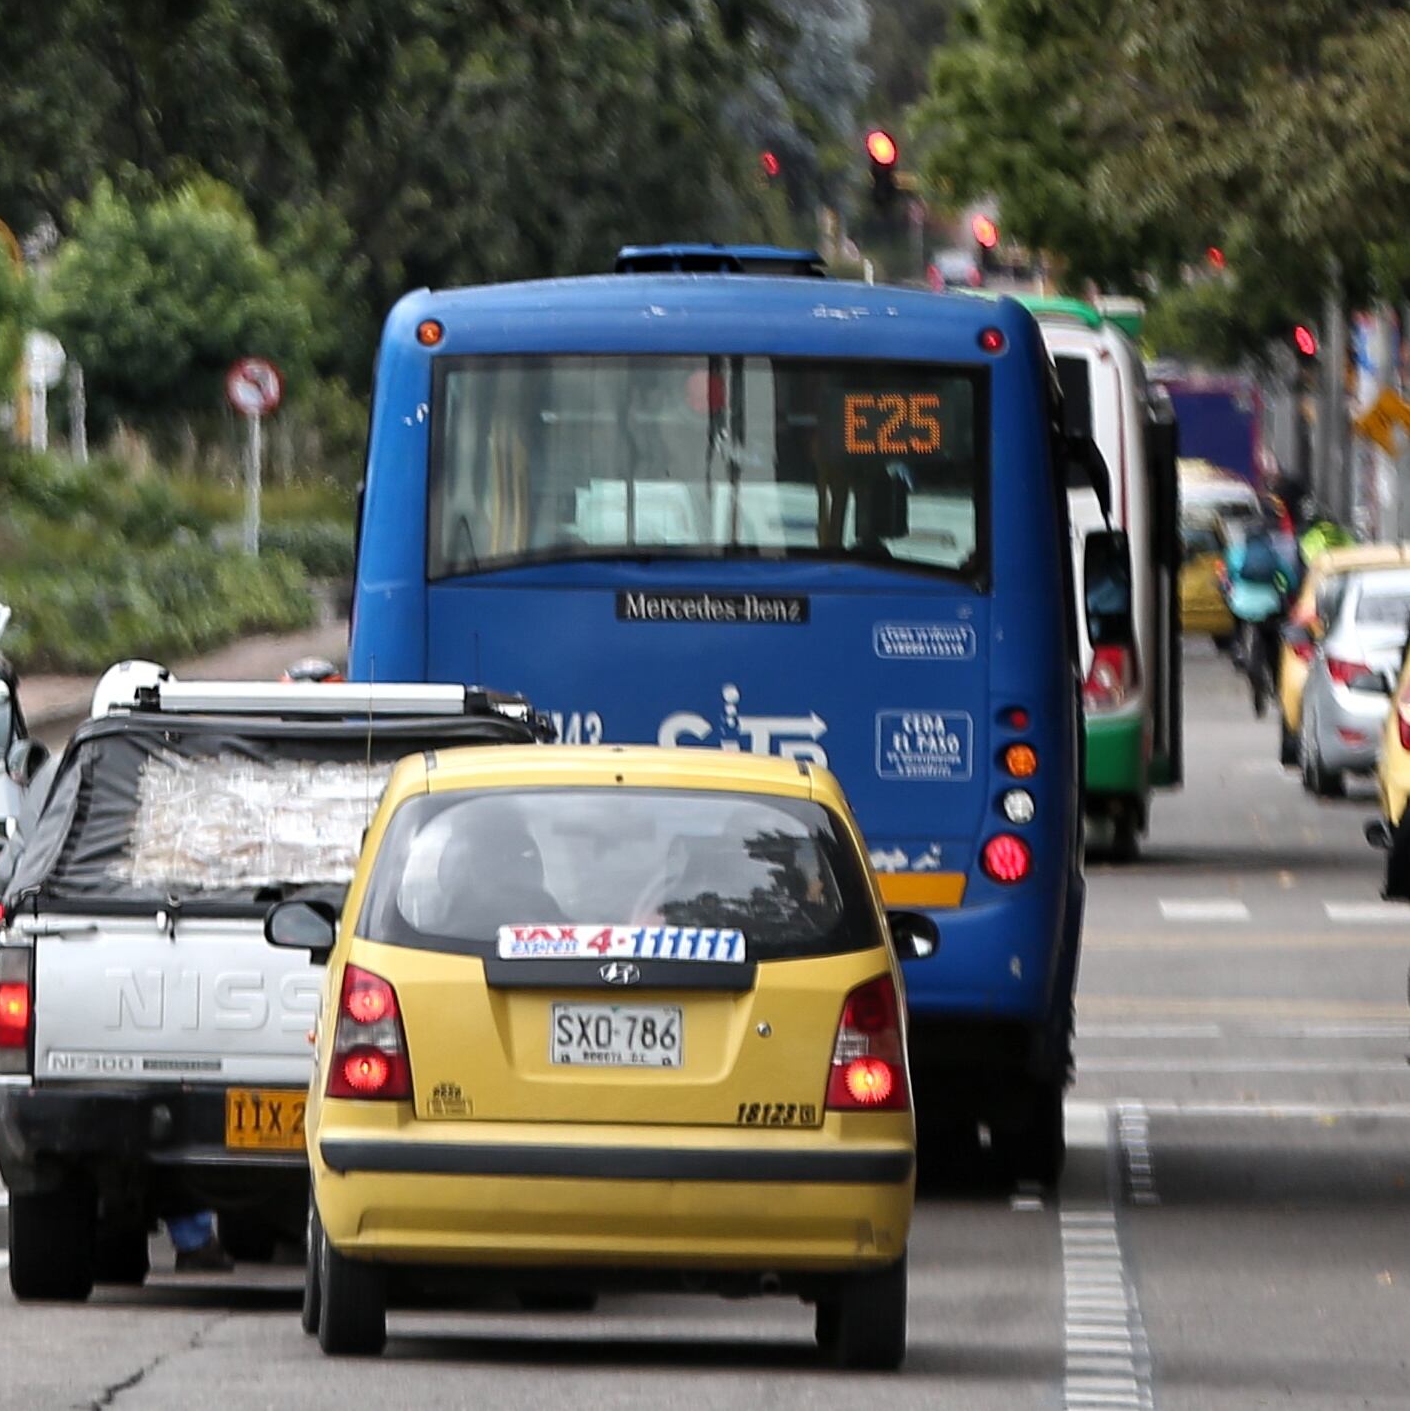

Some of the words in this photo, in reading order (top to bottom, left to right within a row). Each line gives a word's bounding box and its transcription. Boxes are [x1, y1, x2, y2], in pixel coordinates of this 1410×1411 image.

[844, 393, 940, 454] E25
[626, 592, 801, 622] Mercedes-Benz
[105, 968, 322, 1031] NISS
